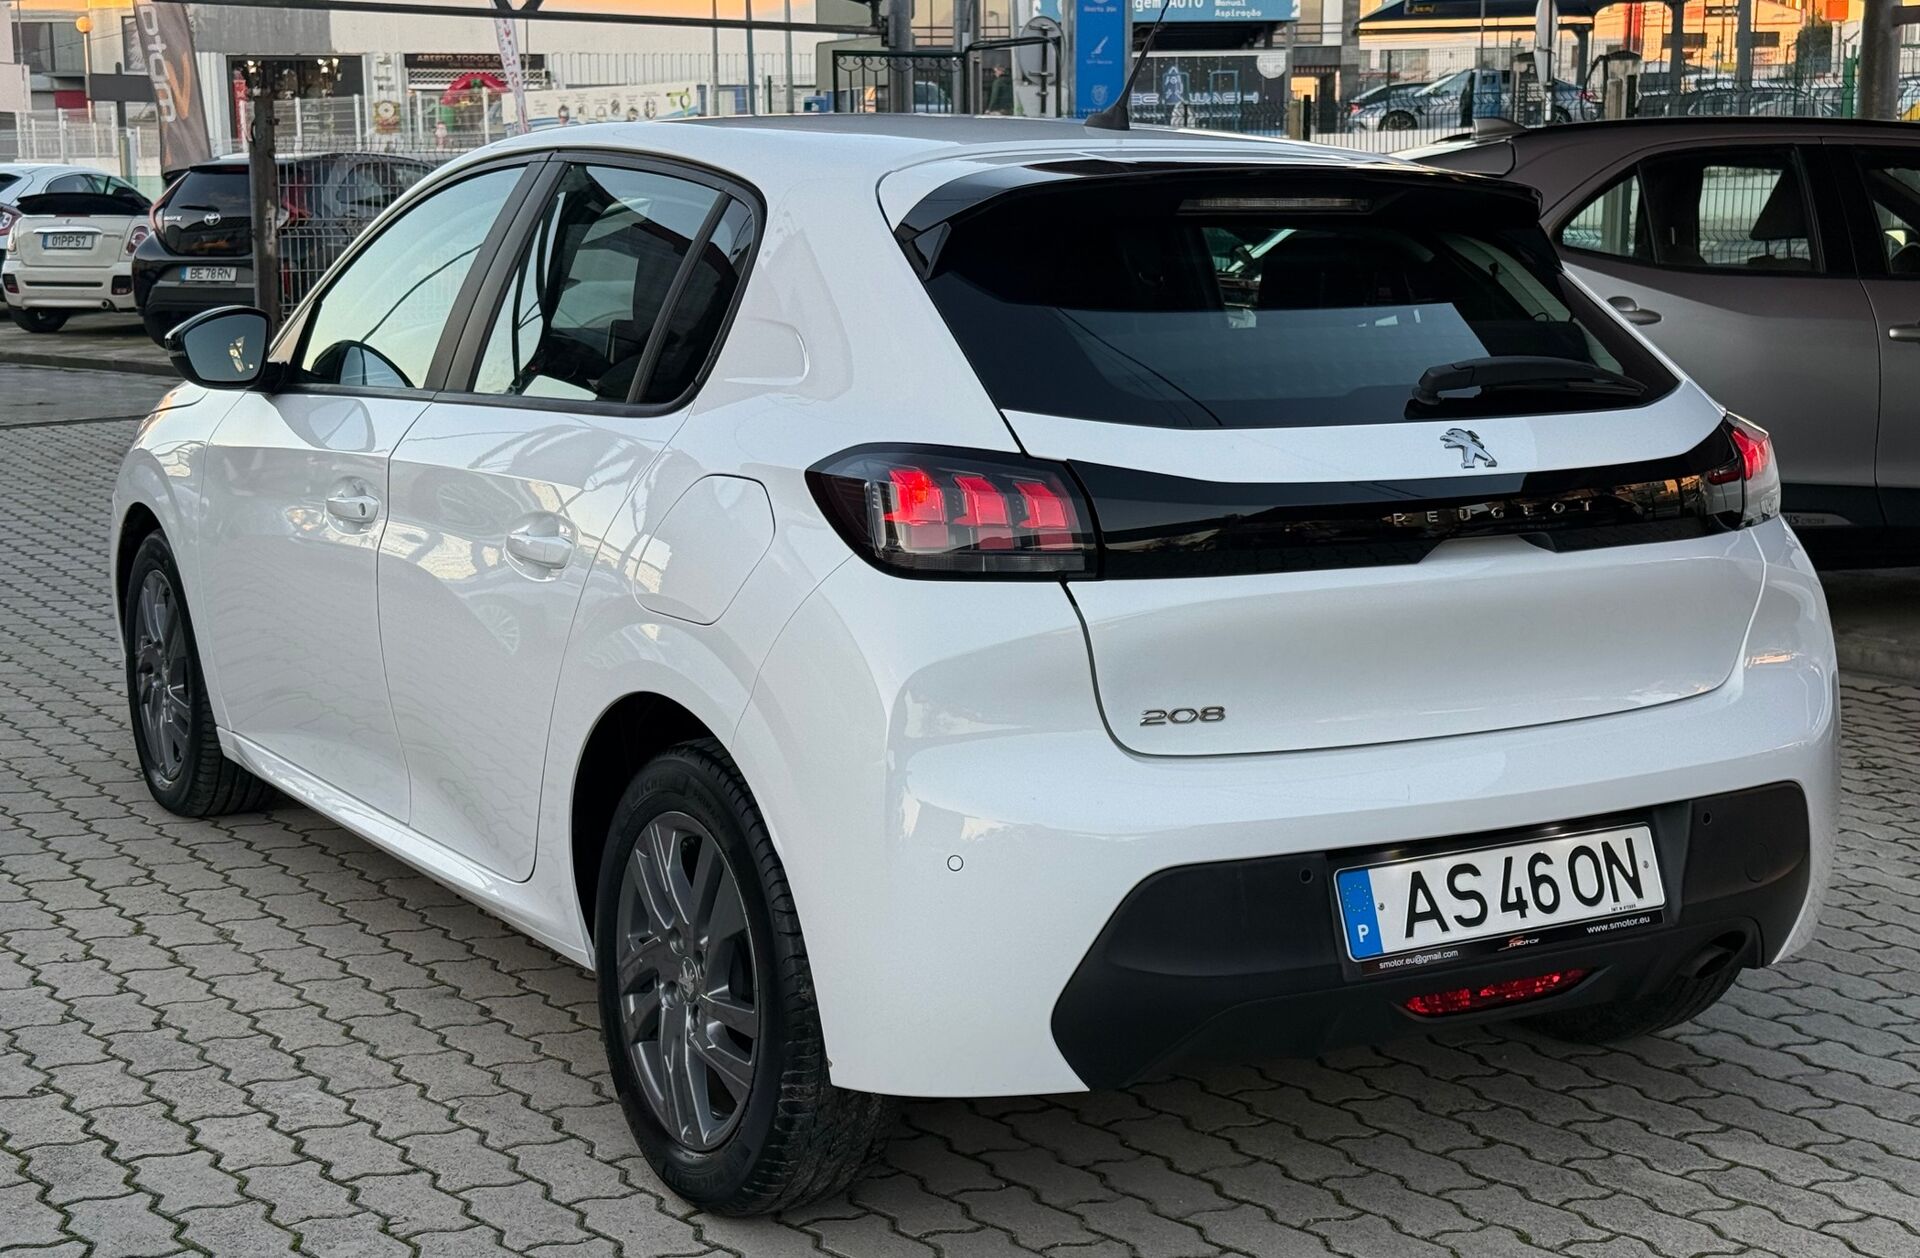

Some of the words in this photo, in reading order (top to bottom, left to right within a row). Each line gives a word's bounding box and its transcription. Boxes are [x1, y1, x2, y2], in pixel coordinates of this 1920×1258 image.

[1215, 9, 1262, 18] Aspiração
[1393, 500, 1592, 527] PEUGEOT
[1140, 706, 1226, 726] 208
[1404, 862, 1489, 940] AS
[1499, 851, 1562, 920] 46
[1567, 837, 1645, 908] ON
[1357, 924, 1370, 943] P
[1586, 916, 1650, 934] www.smotor.eu
[1379, 950, 1459, 970] smotor.eu@gmail.com
